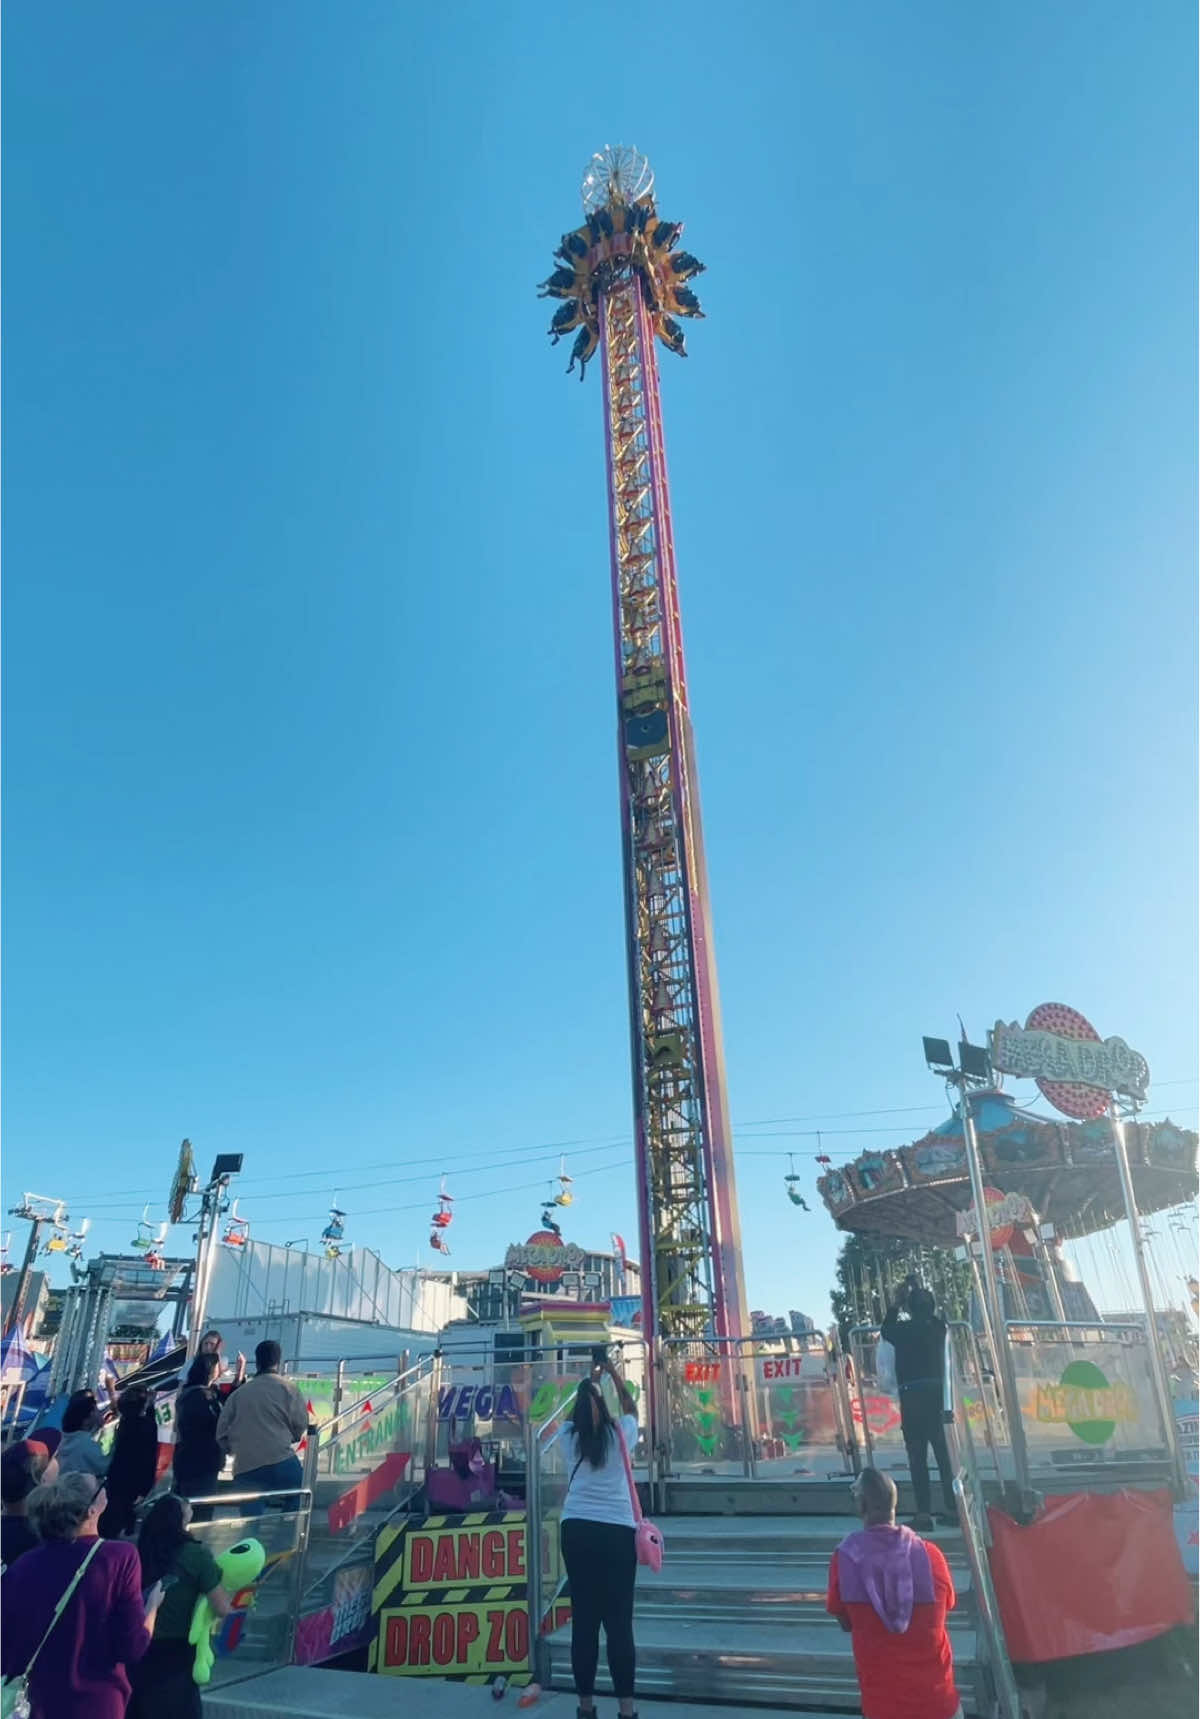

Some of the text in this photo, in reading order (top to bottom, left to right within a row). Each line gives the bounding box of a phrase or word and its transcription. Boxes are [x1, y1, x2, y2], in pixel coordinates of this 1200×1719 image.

[684, 1362, 721, 1383] EXIT
[763, 1358, 803, 1379] EXIT
[384, 1611, 480, 1668] DROP
